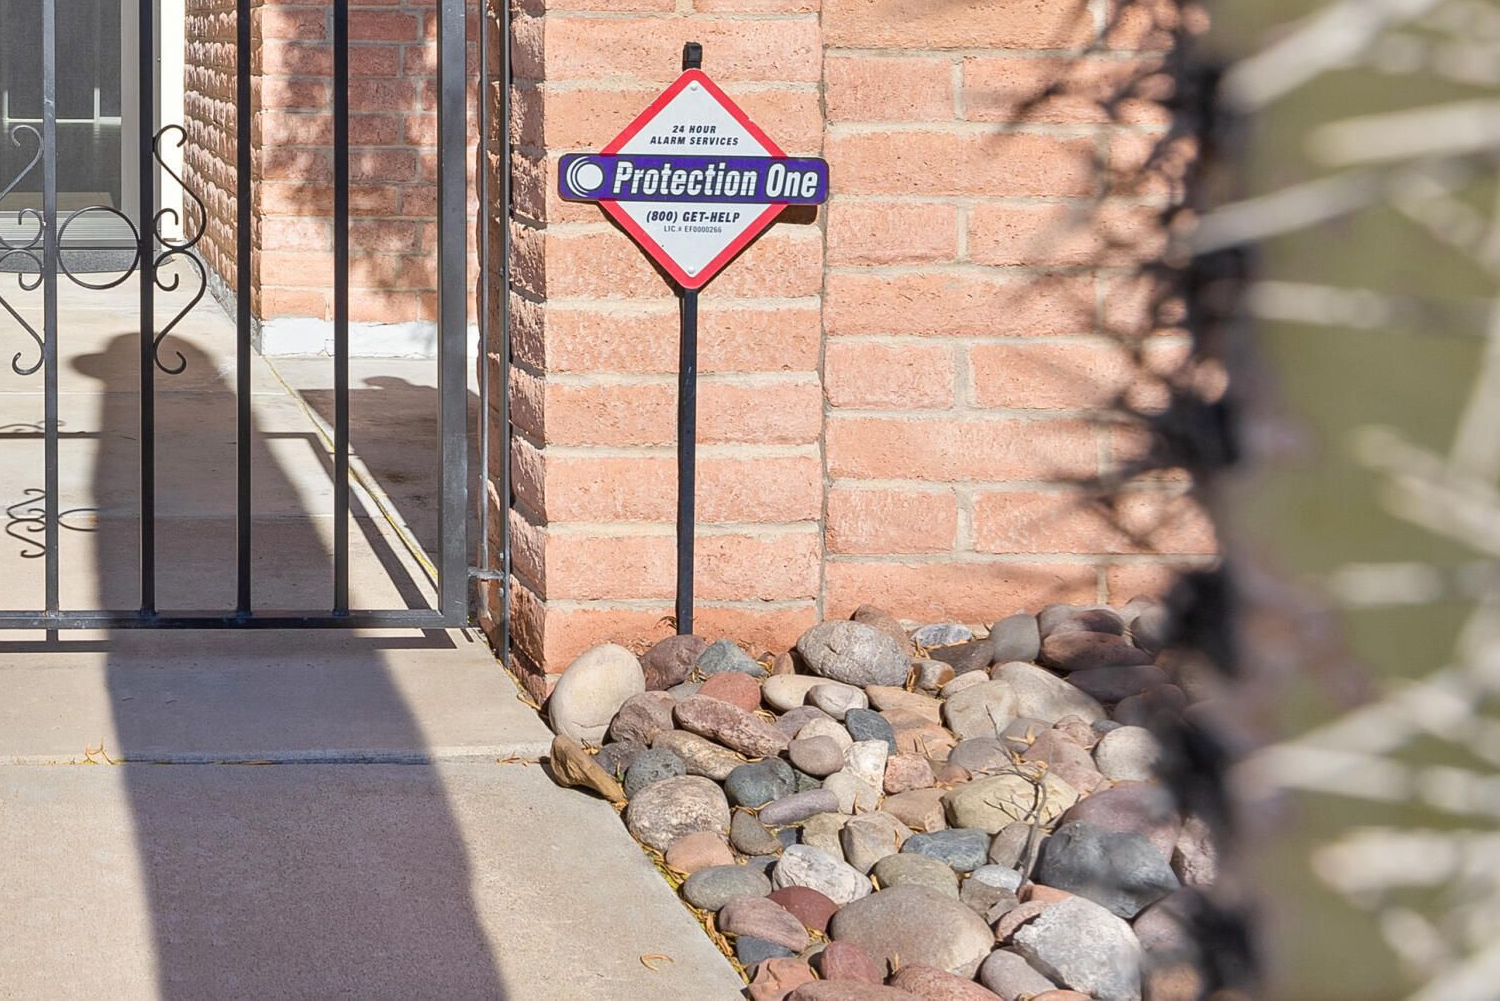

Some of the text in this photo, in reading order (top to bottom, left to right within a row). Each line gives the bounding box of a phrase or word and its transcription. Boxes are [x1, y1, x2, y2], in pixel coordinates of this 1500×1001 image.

[672, 125, 717, 134] 24 HOUR
[650, 136, 739, 146] ALARM SERVICES
[612, 161, 819, 198] Protection One
[646, 210, 740, 224] (800) GET-HELP
